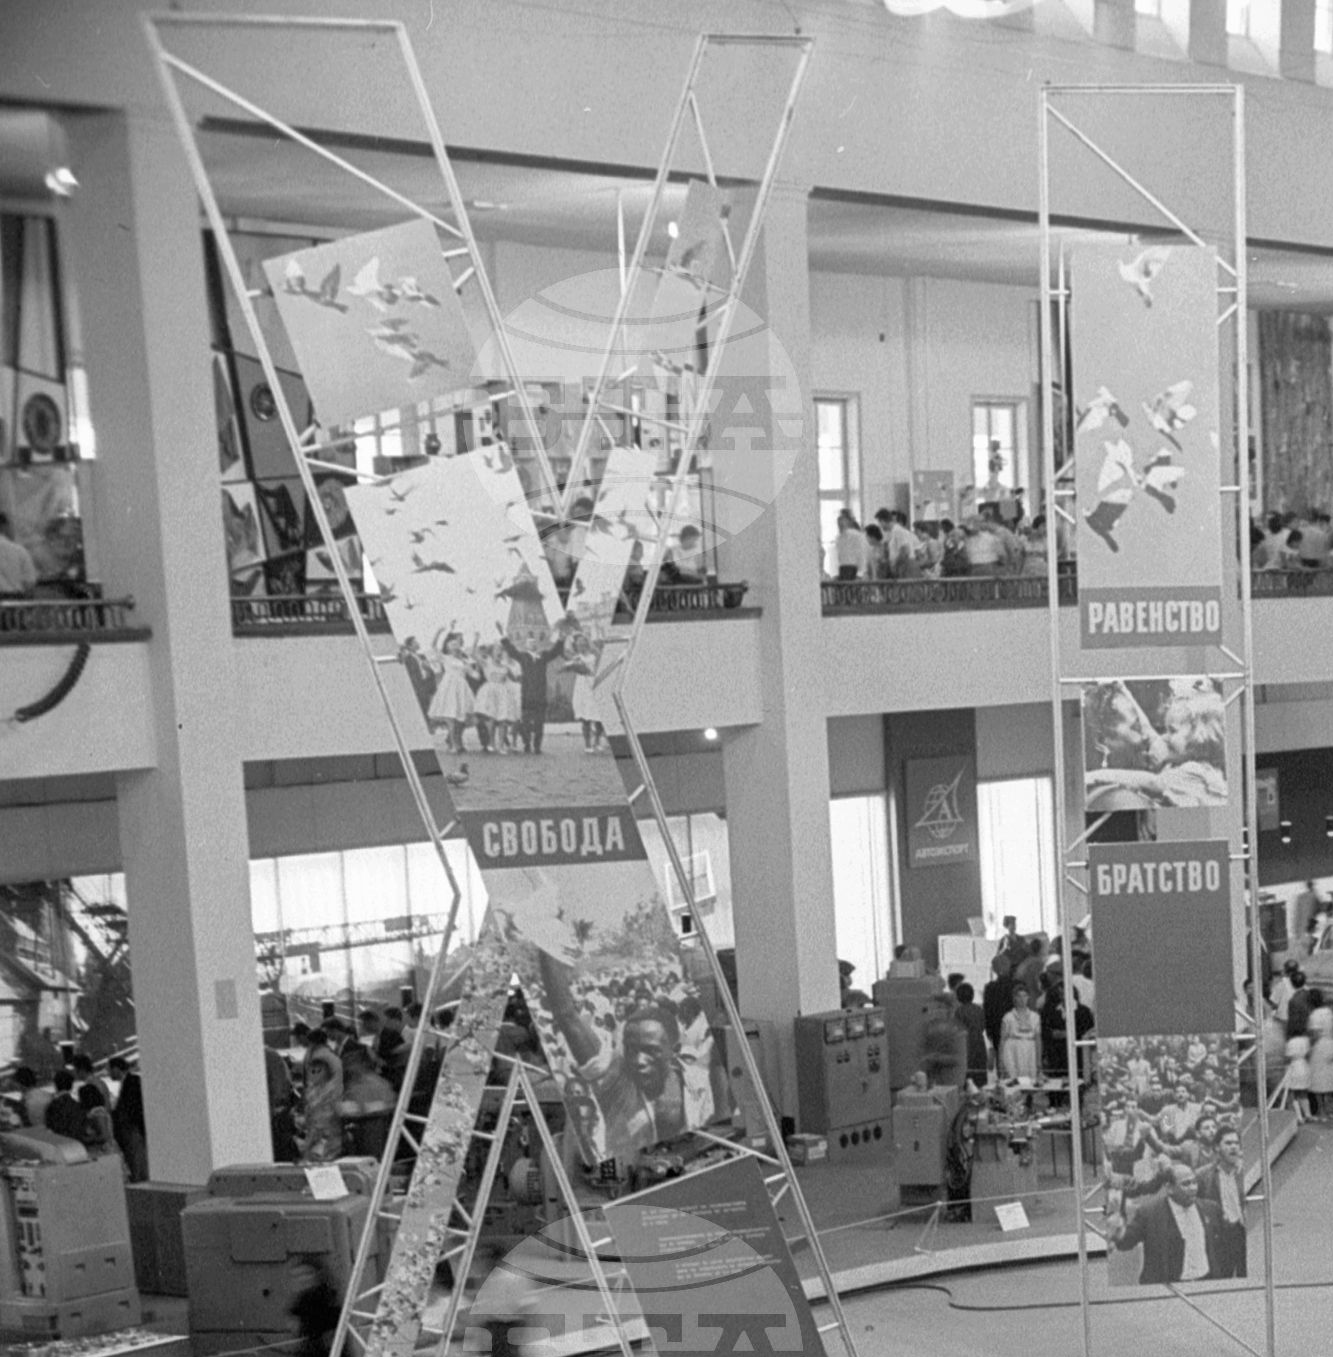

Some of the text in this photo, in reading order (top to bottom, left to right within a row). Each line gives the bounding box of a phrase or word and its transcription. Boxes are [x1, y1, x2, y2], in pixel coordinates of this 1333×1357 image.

[1088, 600, 1220, 634] РАВЕНСТВО
[482, 816, 625, 858] СВОБОДА
[1096, 859, 1221, 896] БРАТСТВО
